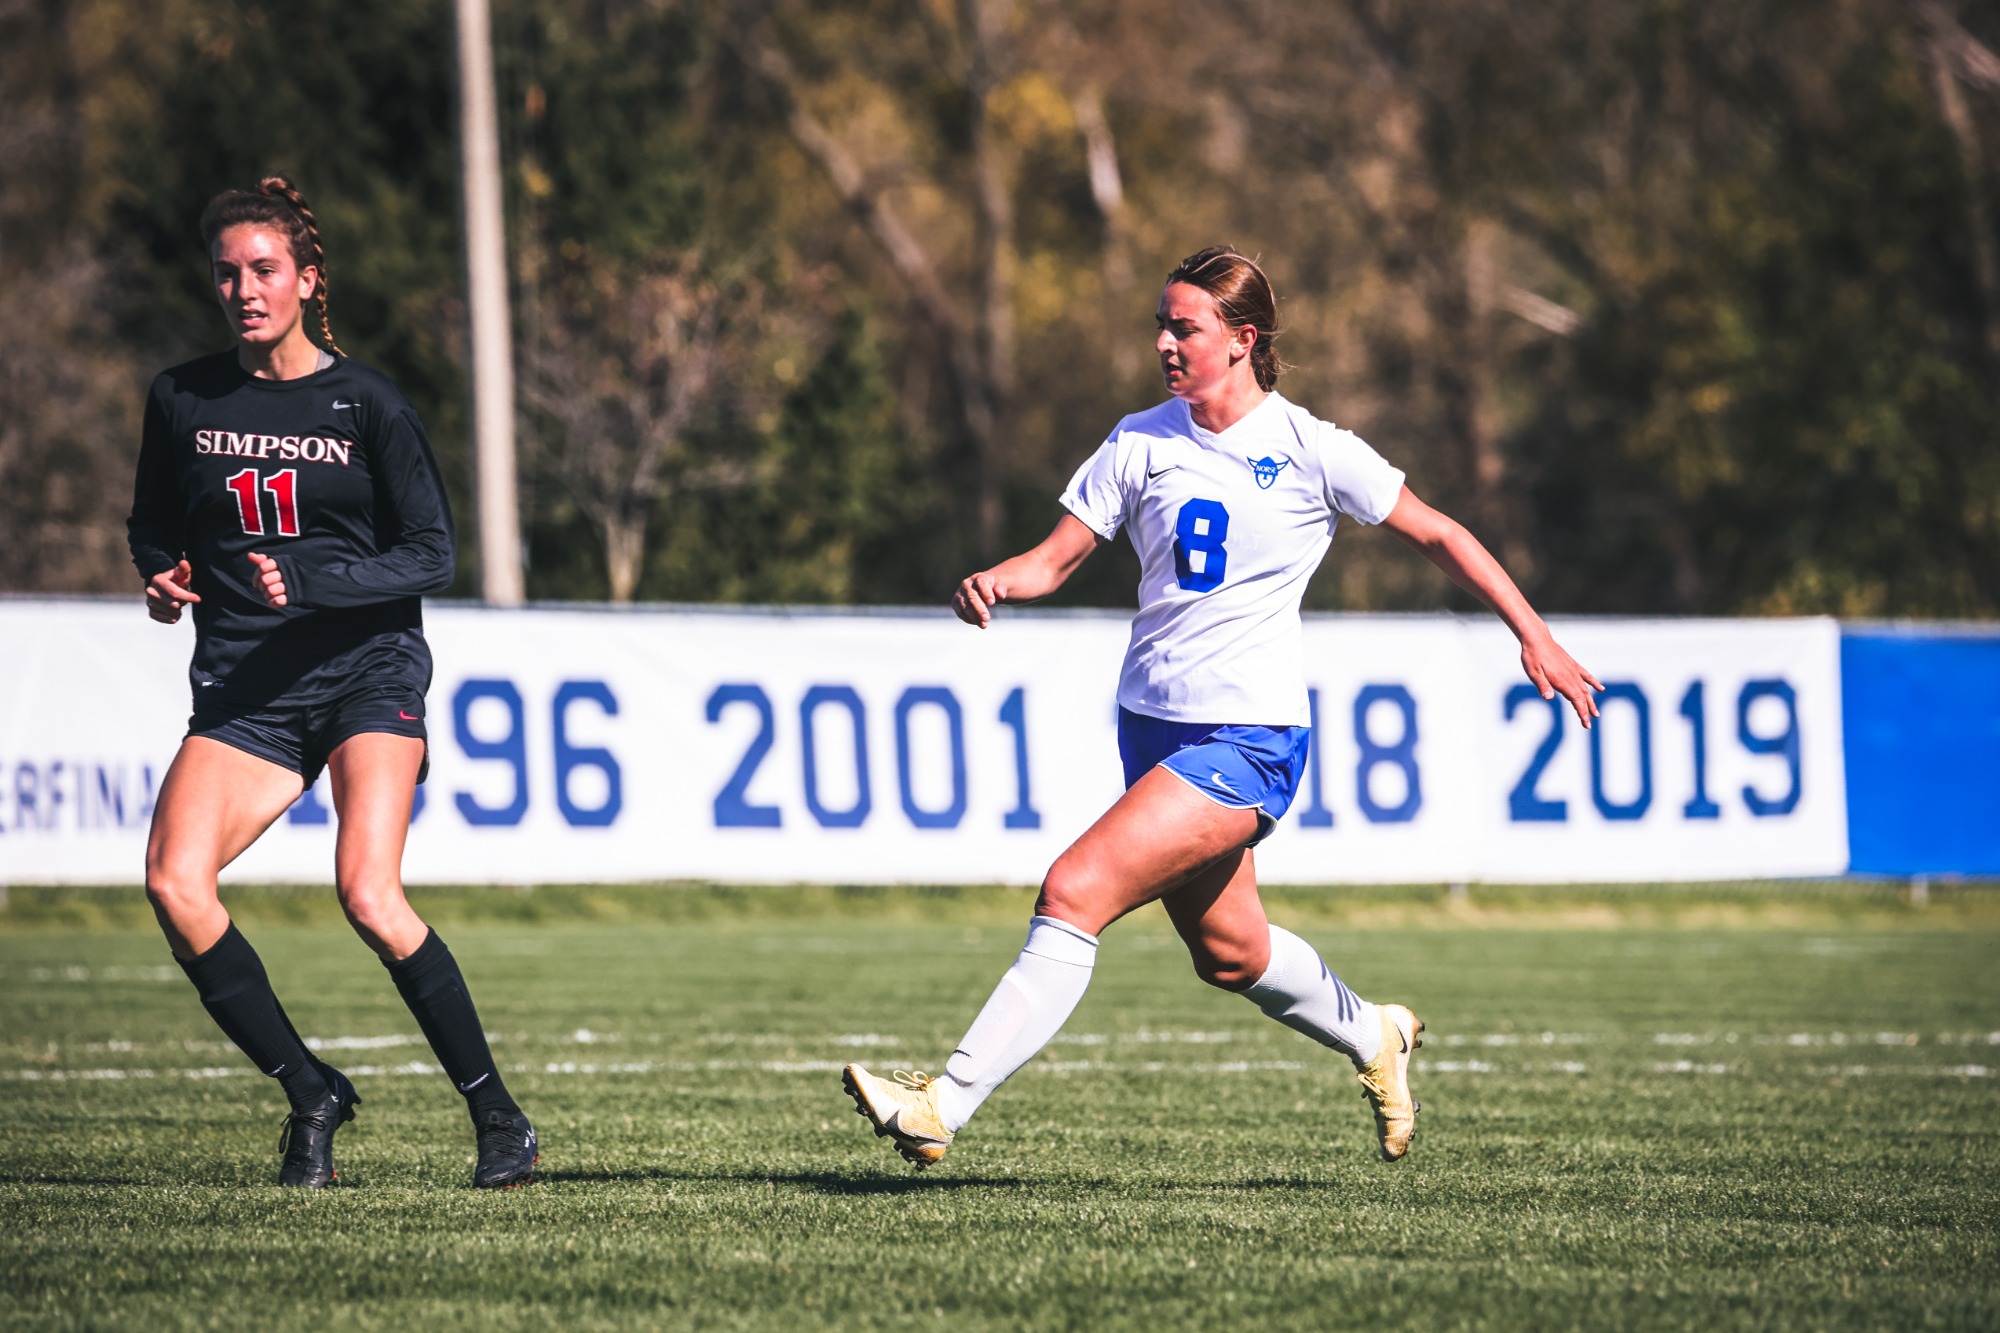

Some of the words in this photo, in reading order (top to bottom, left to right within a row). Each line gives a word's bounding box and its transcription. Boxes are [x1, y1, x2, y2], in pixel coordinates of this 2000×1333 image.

[195, 429, 352, 465] SIMPSON
[1255, 465, 1277, 475] NORSE
[226, 467, 300, 537] 11
[1173, 497, 1230, 594] 8
[0, 761, 156, 833] RFINA
[288, 678, 623, 827] 96
[705, 683, 1041, 829] 2001
[1502, 678, 1802, 823] 2019
